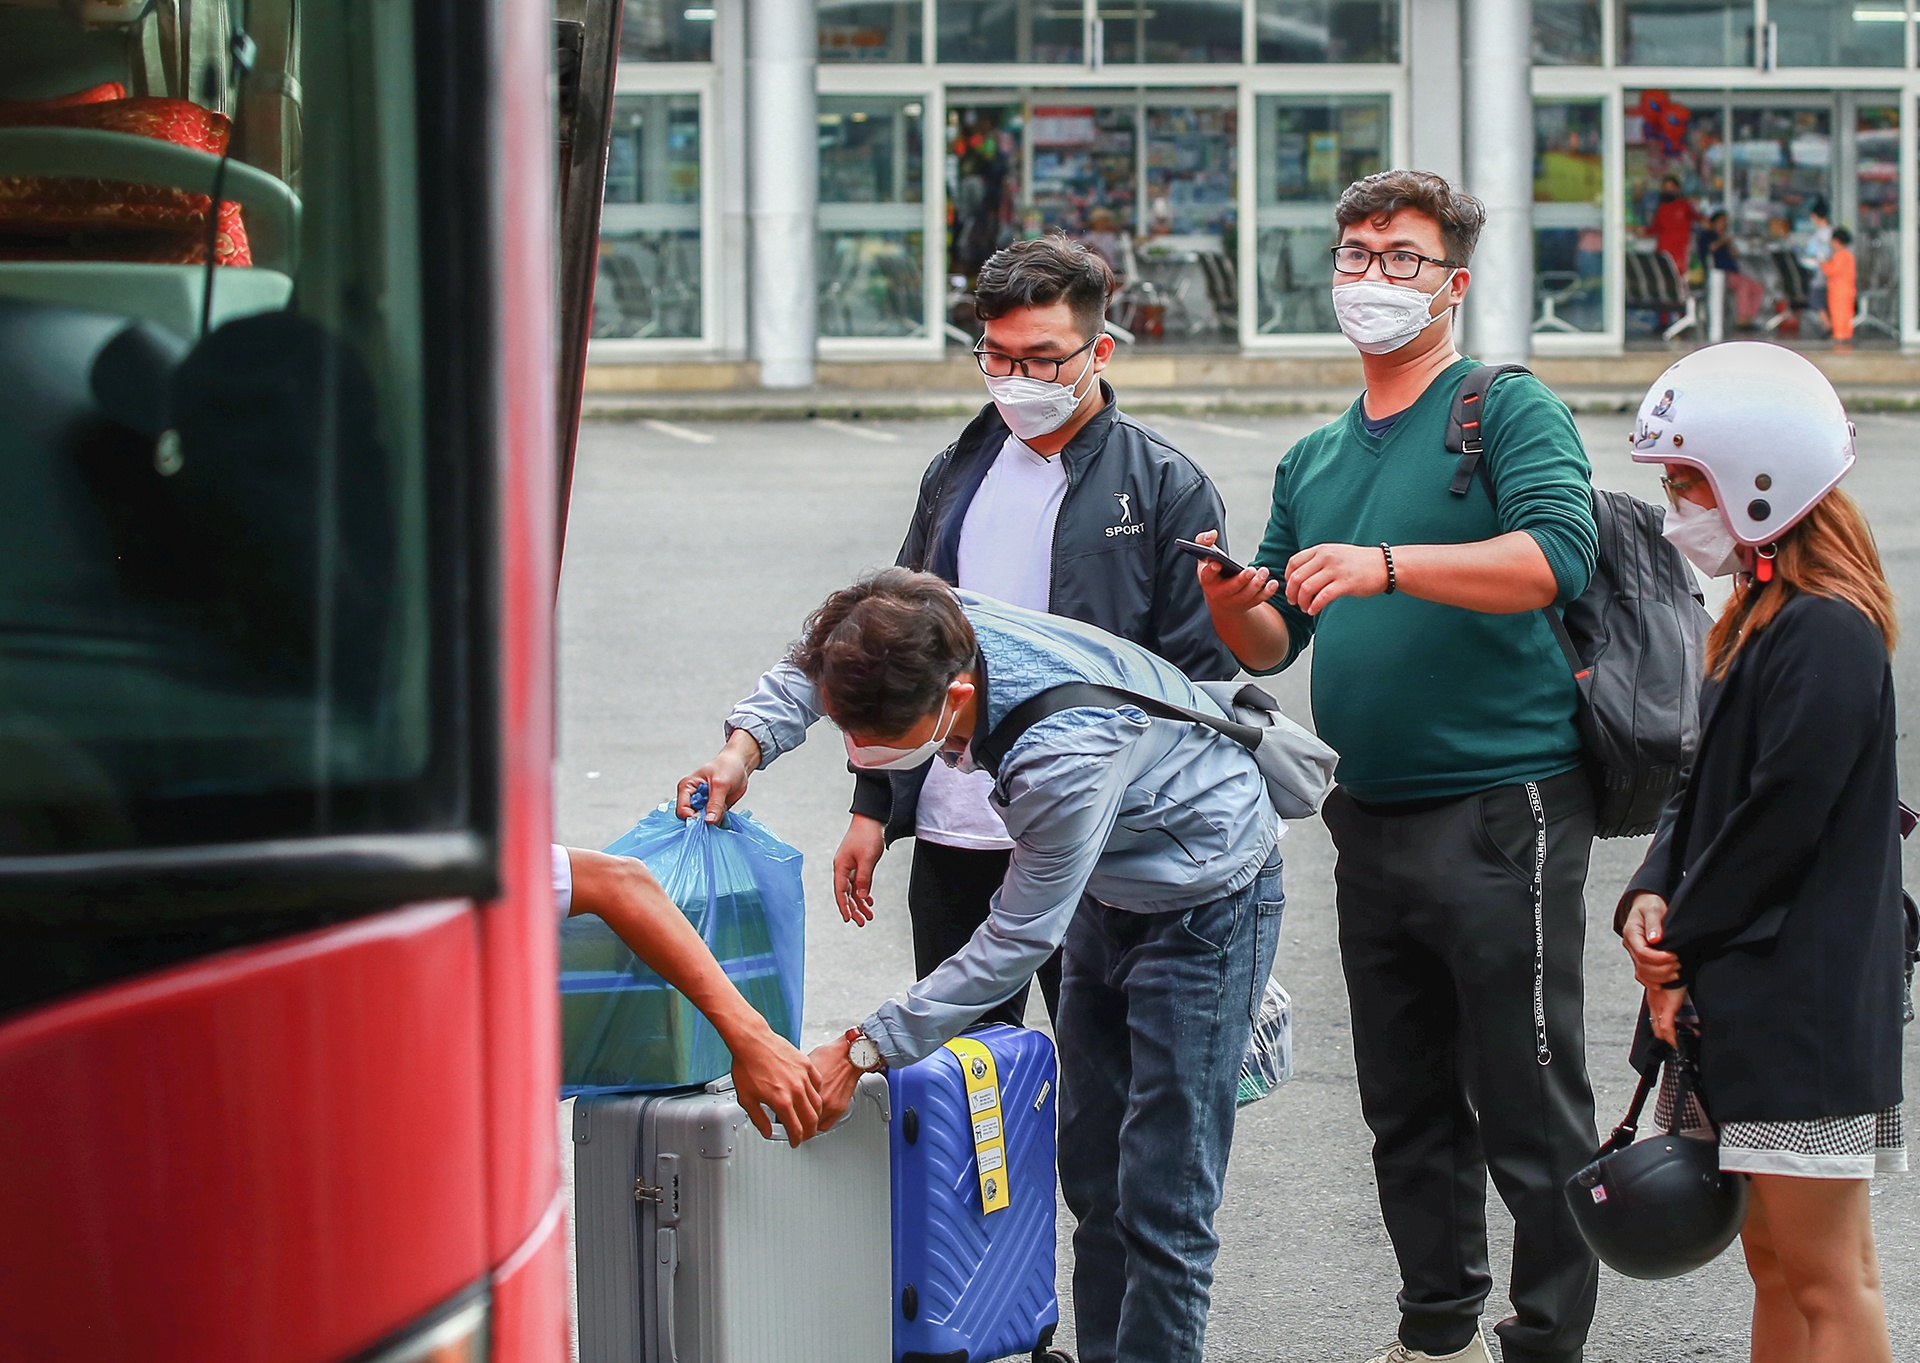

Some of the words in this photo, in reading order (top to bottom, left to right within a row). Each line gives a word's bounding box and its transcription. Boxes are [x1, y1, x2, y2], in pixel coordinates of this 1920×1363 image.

[1105, 523, 1145, 537] SPORT
[1534, 830, 1545, 883] DSQUARED2
[1534, 903, 1543, 957] DSQUARED2
[1535, 974, 1545, 1027] DSQUARED2
